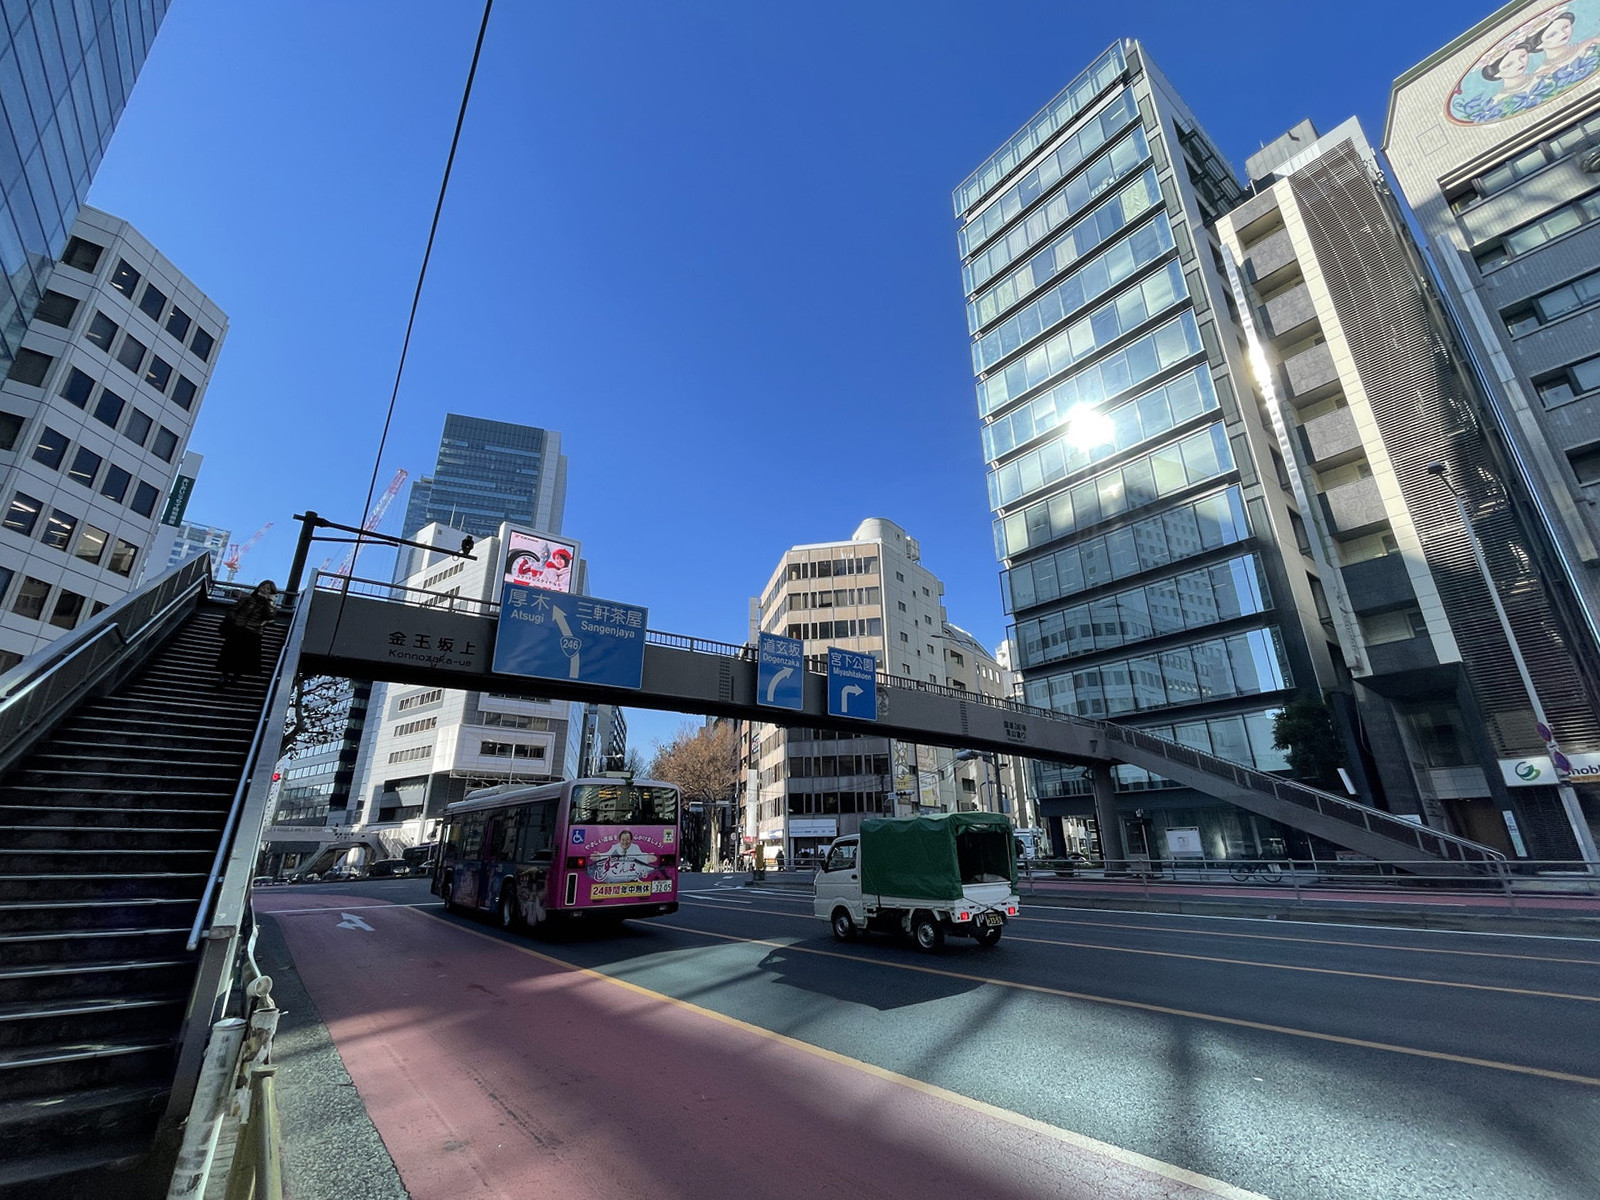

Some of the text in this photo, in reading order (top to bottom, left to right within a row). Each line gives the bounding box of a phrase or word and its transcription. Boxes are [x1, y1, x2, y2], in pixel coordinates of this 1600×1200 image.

[507, 588, 551, 612] 厚木
[510, 609, 545, 625] Atsugi
[575, 601, 643, 629] 三軒茶屋
[580, 620, 635, 639] Sangenjaya
[388, 631, 476, 656] 金王坂上
[562, 639, 579, 650] 246
[763, 638, 800, 658] 道玄坂
[388, 649, 472, 668] Konnozaka-ue
[762, 652, 800, 668] Dogenzaka
[830, 652, 874, 672] 宮下公園
[833, 667, 872, 681] Miyashitakoen
[593, 885, 649, 895] 24時間年中無休
